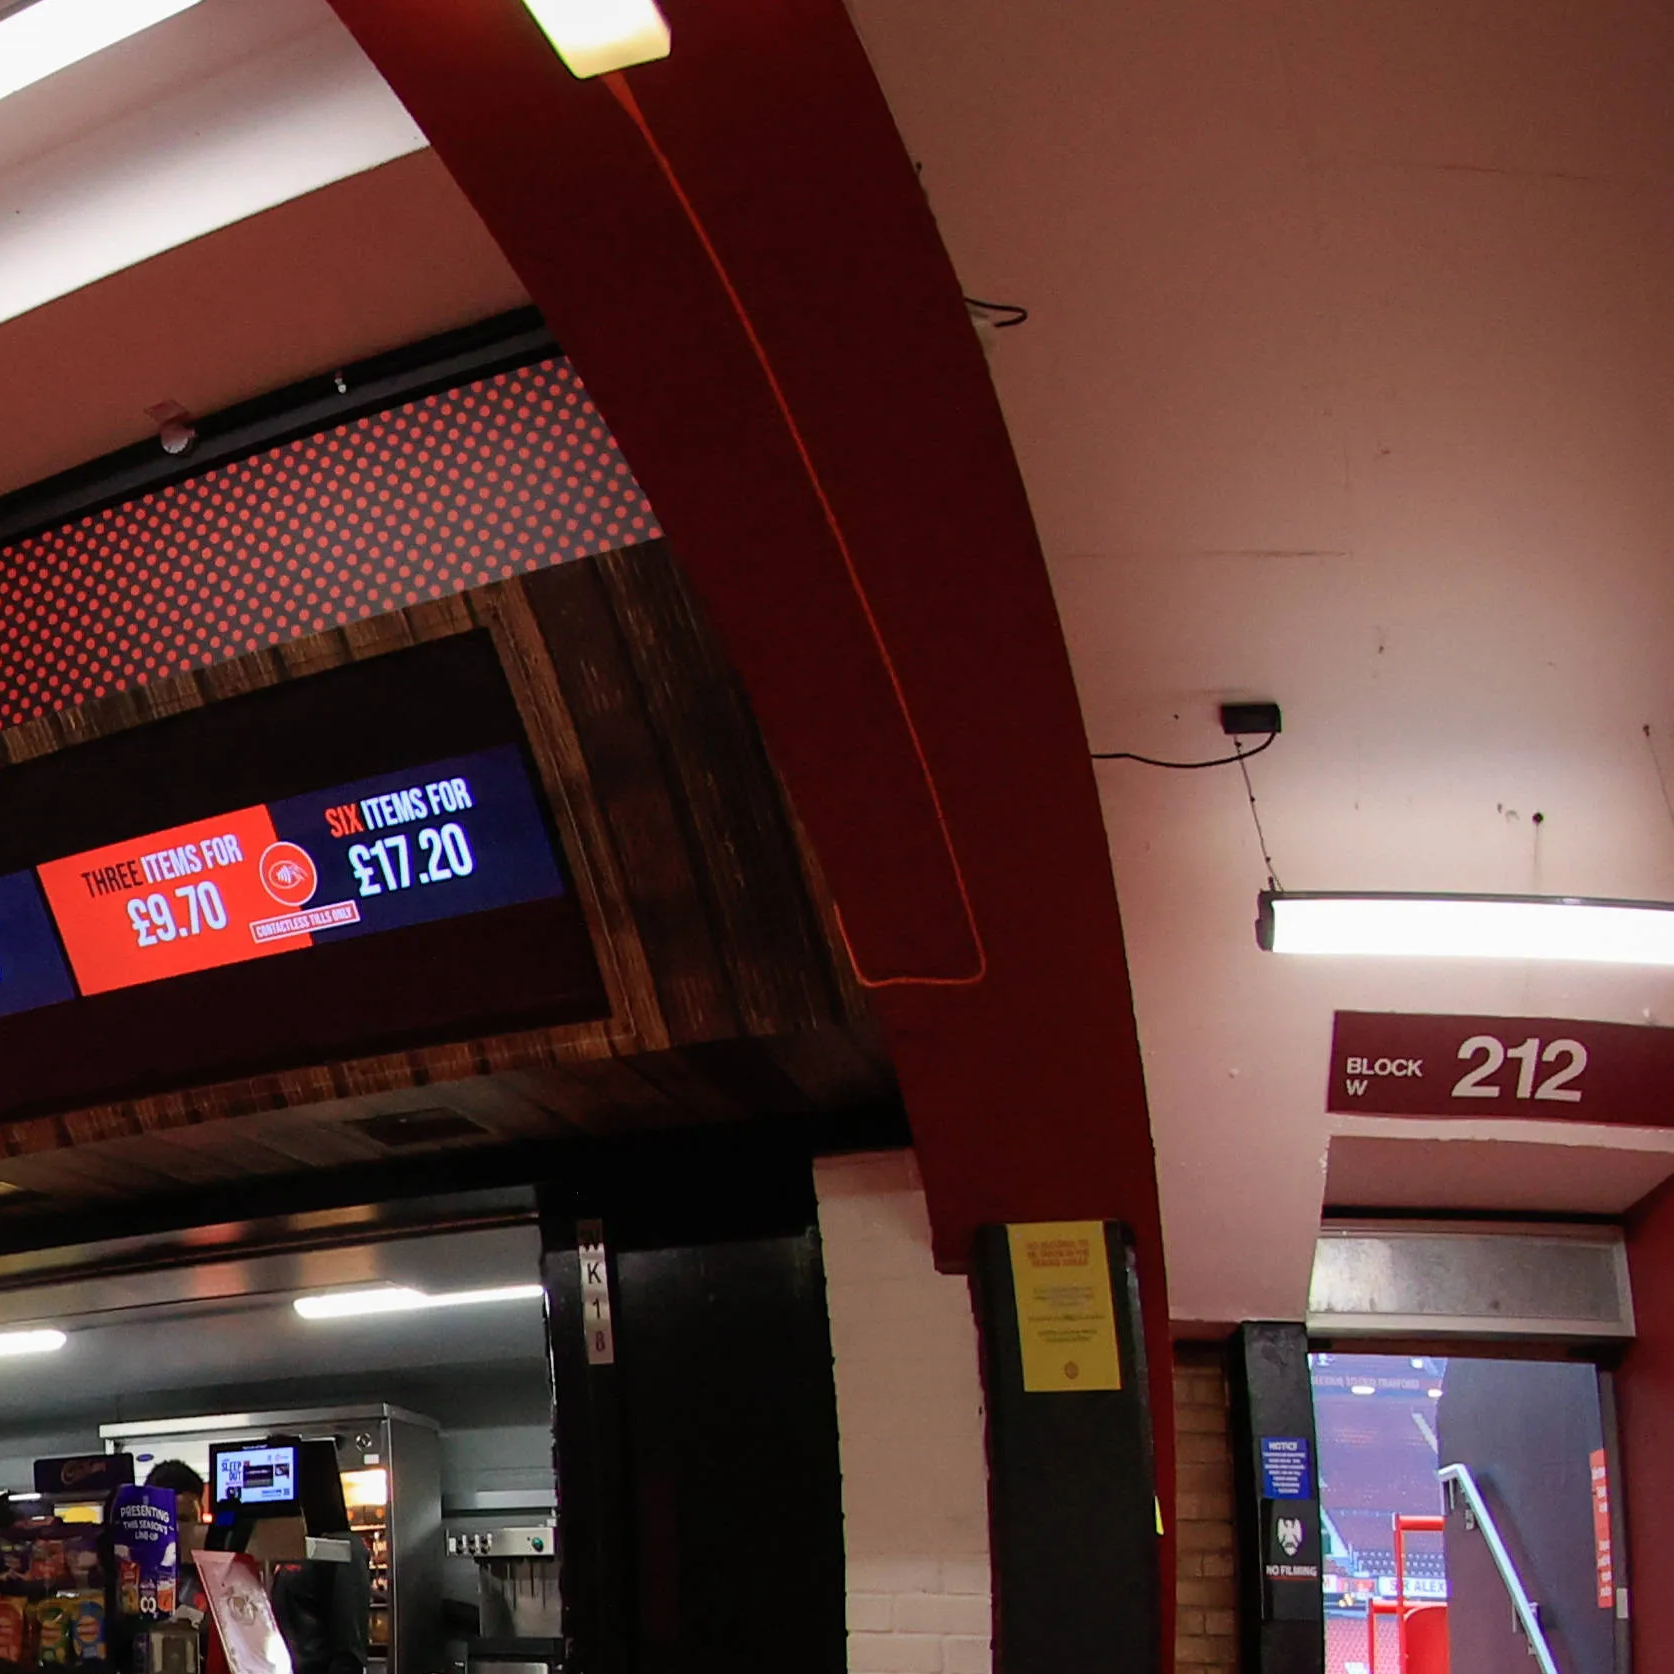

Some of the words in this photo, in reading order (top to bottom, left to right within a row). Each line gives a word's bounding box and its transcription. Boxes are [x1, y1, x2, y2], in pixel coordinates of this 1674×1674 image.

[325, 803, 363, 838] SIX
[359, 791, 427, 832] ITEMS
[424, 777, 473, 816] FOR
[81, 860, 144, 899] THREE
[140, 842, 204, 884] ITEMS
[200, 833, 244, 868] FOR
[347, 822, 474, 897] £17.20
[126, 880, 228, 947] £9.70
[1346, 1057, 1424, 1078] BLOCK
[1451, 1035, 1588, 1102] 212
[1346, 1080, 1368, 1096] W
[120, 1504, 170, 1523] PRESENTING
[1266, 1565, 1279, 1576] NO
[1280, 1565, 1317, 1577] FILMING
